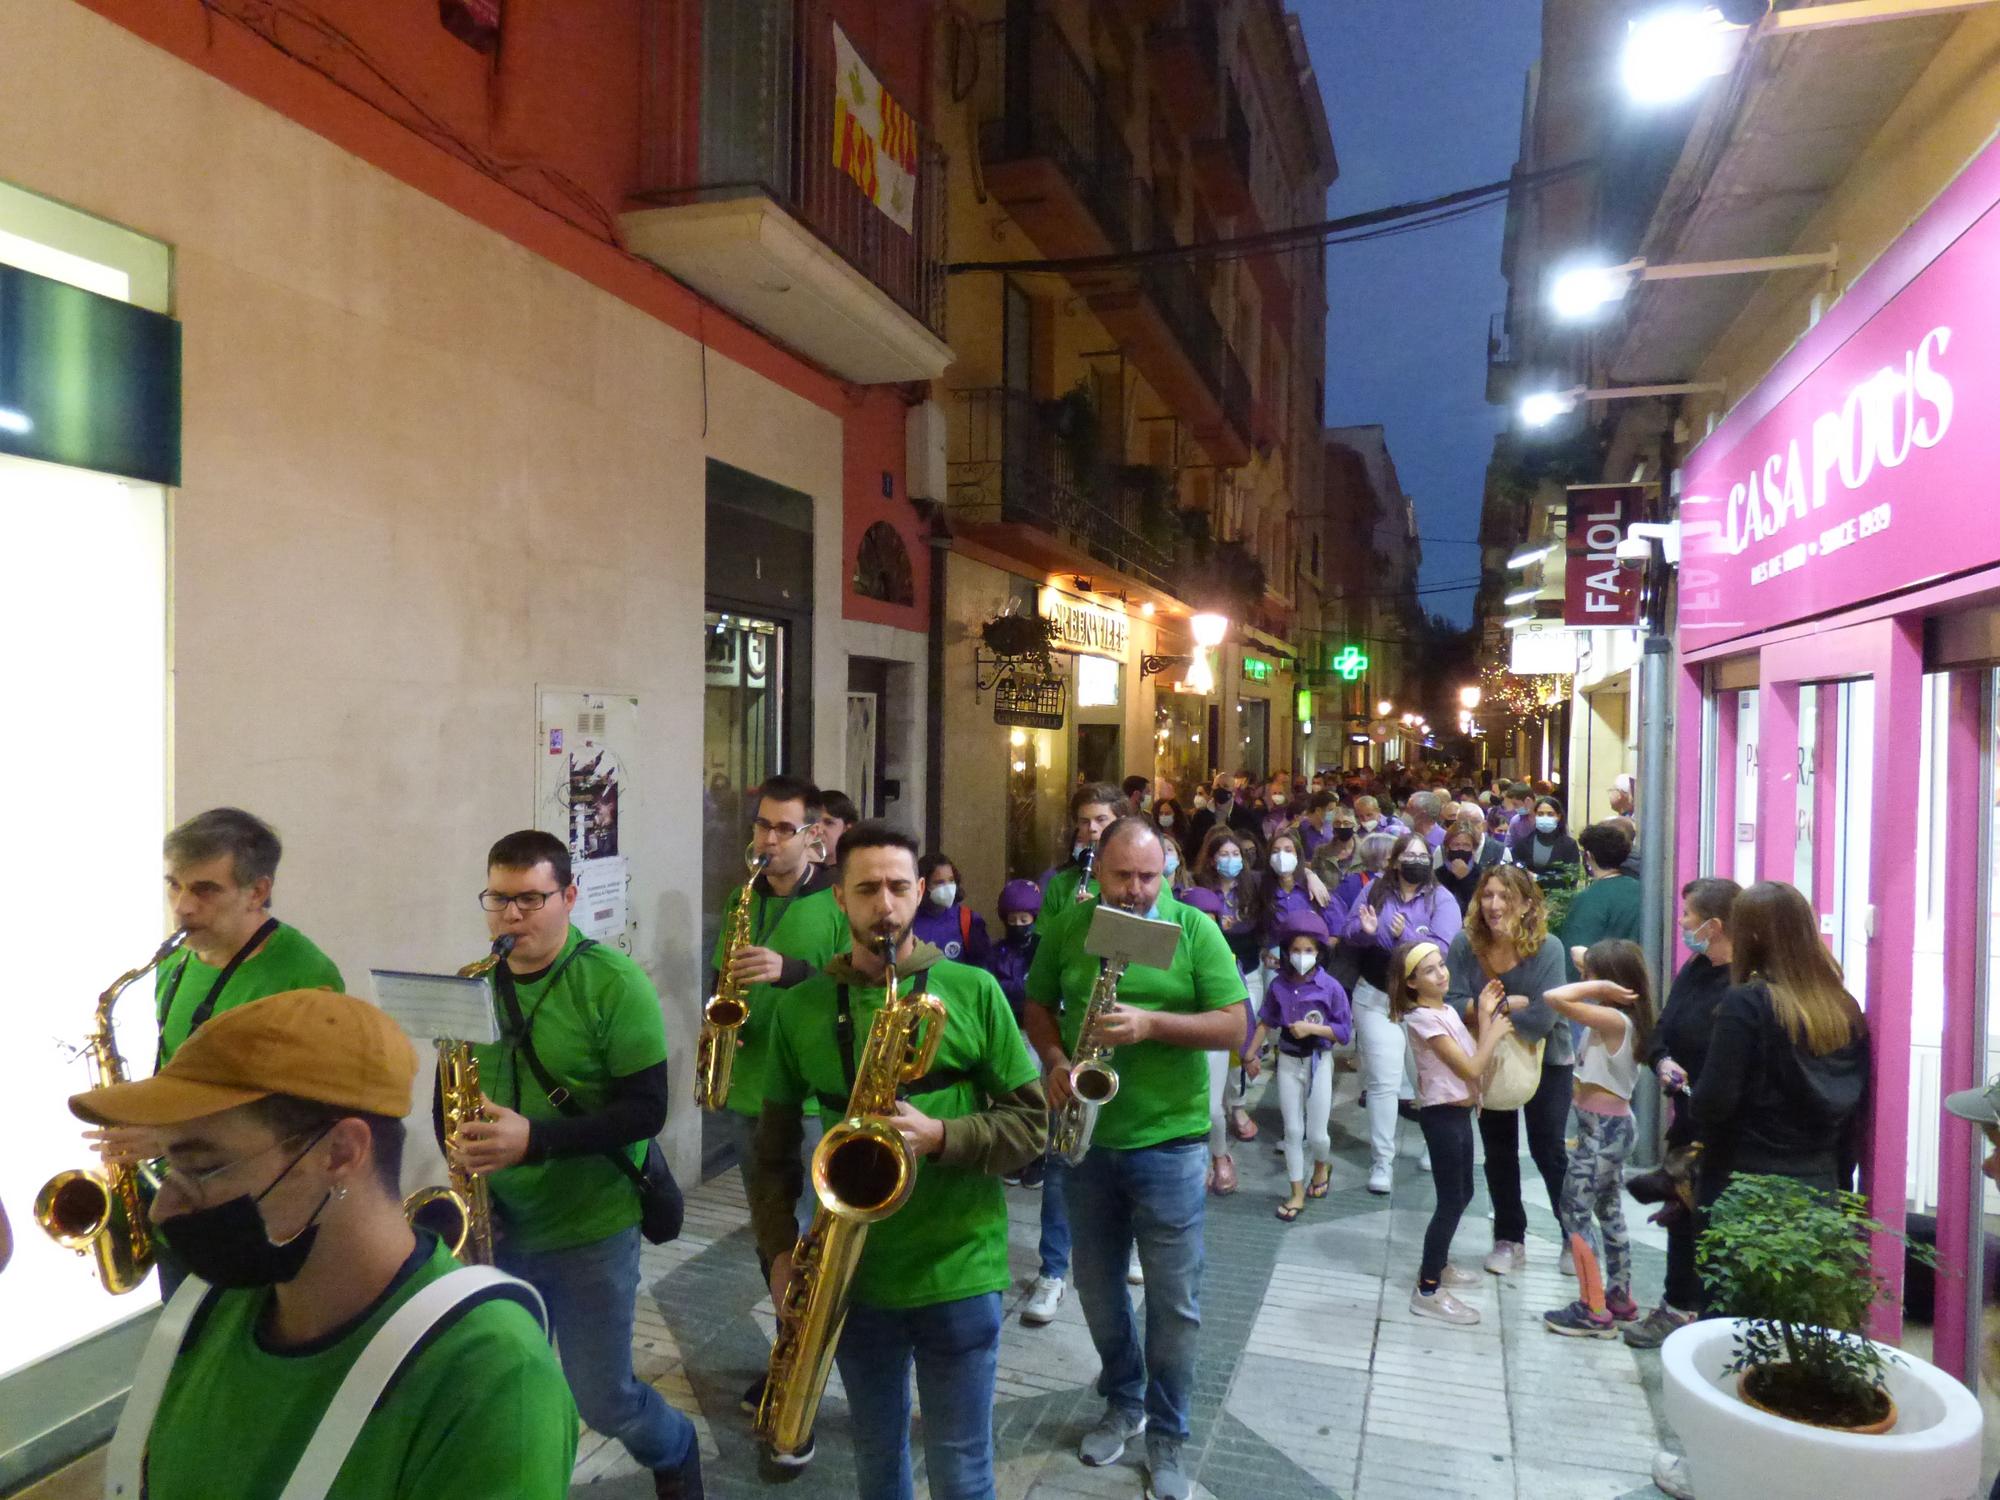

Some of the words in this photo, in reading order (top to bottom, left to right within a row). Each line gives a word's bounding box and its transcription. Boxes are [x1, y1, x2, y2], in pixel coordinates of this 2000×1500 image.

[1726, 437, 1807, 556] CASA
[1811, 326, 1953, 509] POUS
[1585, 500, 1622, 613] FAJOL
